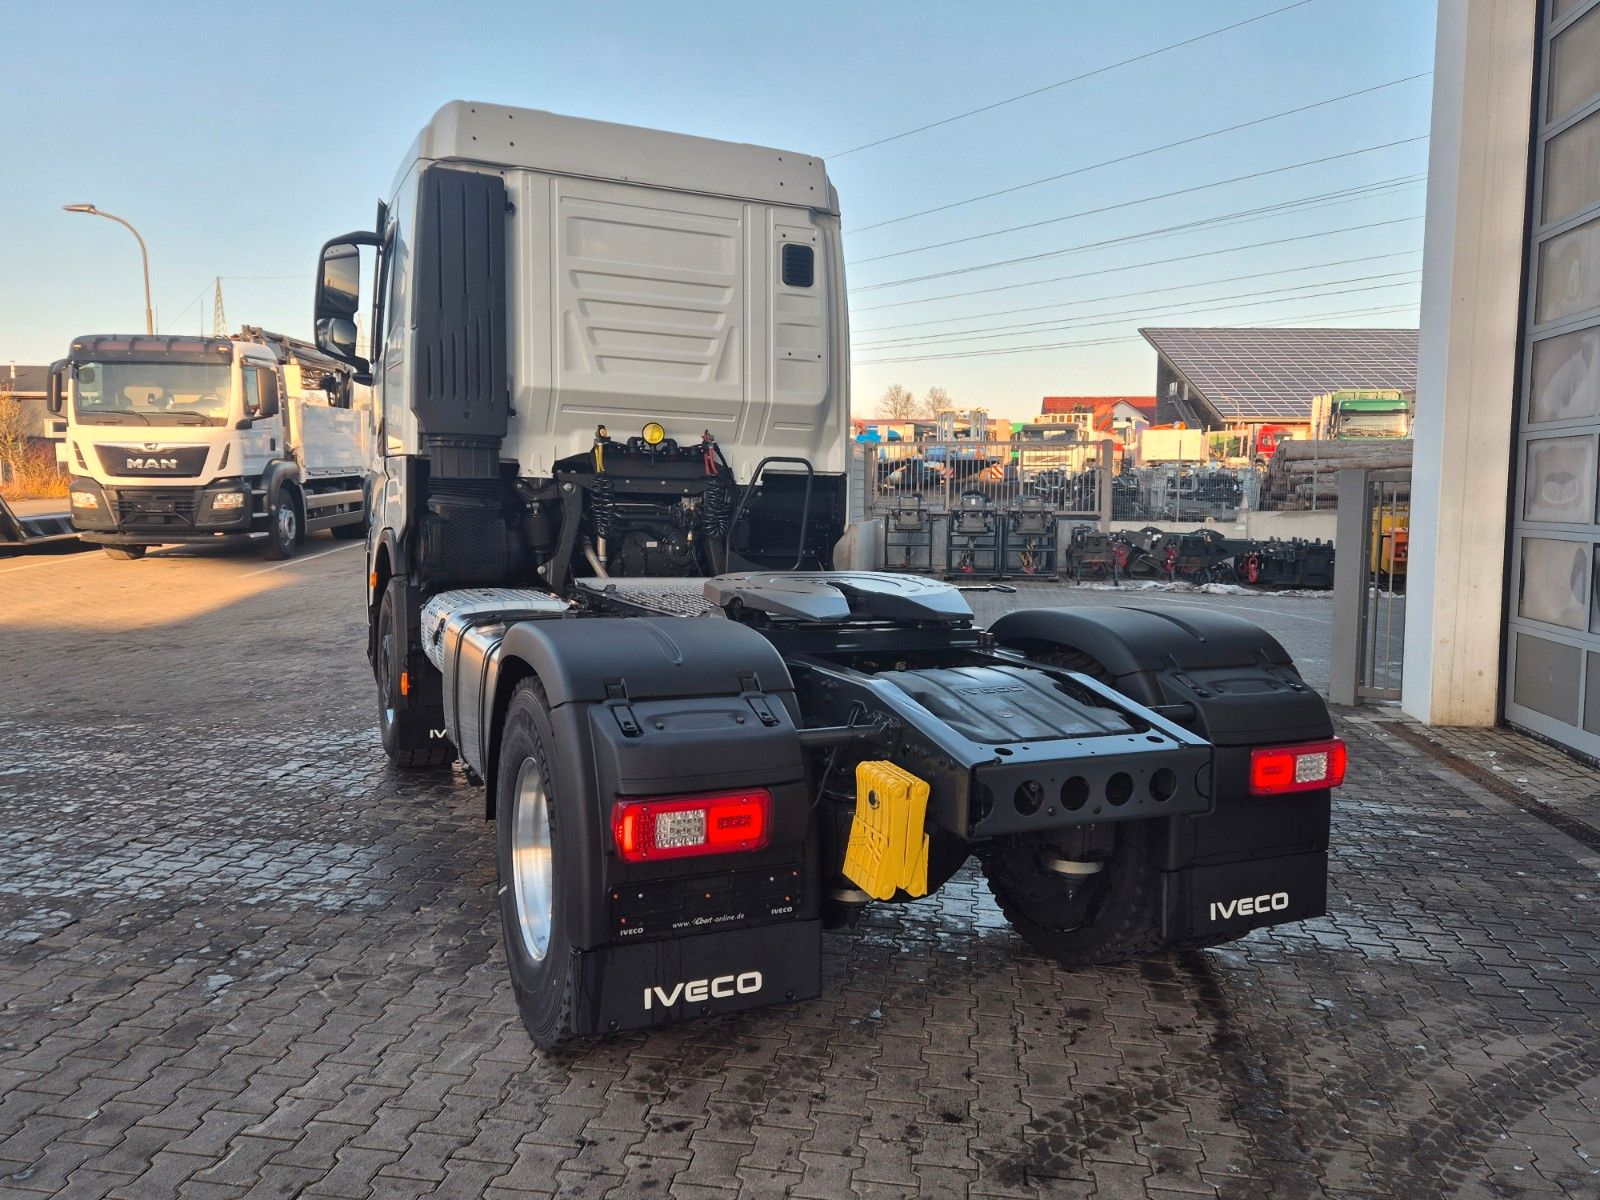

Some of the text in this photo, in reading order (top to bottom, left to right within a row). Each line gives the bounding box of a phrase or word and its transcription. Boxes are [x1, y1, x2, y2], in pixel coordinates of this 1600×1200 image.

[126, 458, 177, 469] MAN
[771, 906, 793, 915] IVECO
[1210, 892, 1289, 921] IVECO
[620, 927, 644, 937] IVECO
[644, 971, 763, 1010] IVECO
